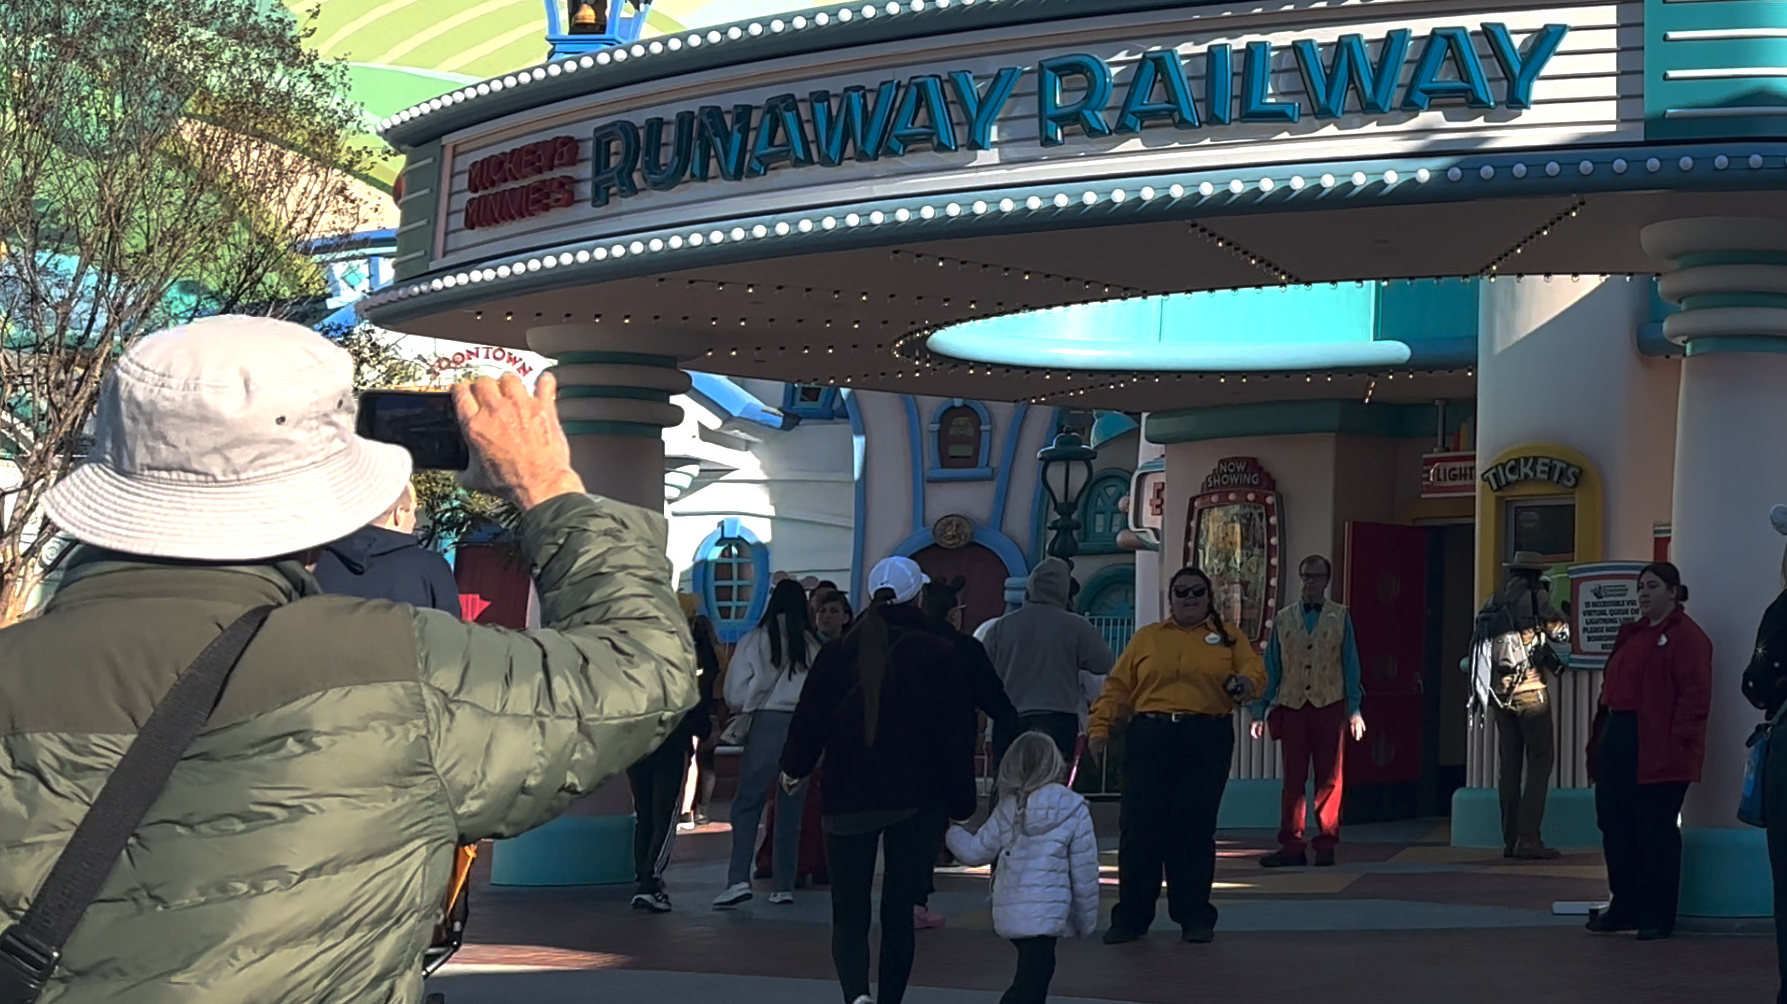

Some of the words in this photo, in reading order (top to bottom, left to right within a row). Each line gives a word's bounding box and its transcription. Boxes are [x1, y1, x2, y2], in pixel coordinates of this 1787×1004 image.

[591, 66, 1023, 208] RUNAWAY
[1038, 22, 1570, 147] RAILWAY
[1207, 472, 1260, 488] SHOWING
[1219, 461, 1247, 474] NOW
[1482, 455, 1582, 492] TICKETS
